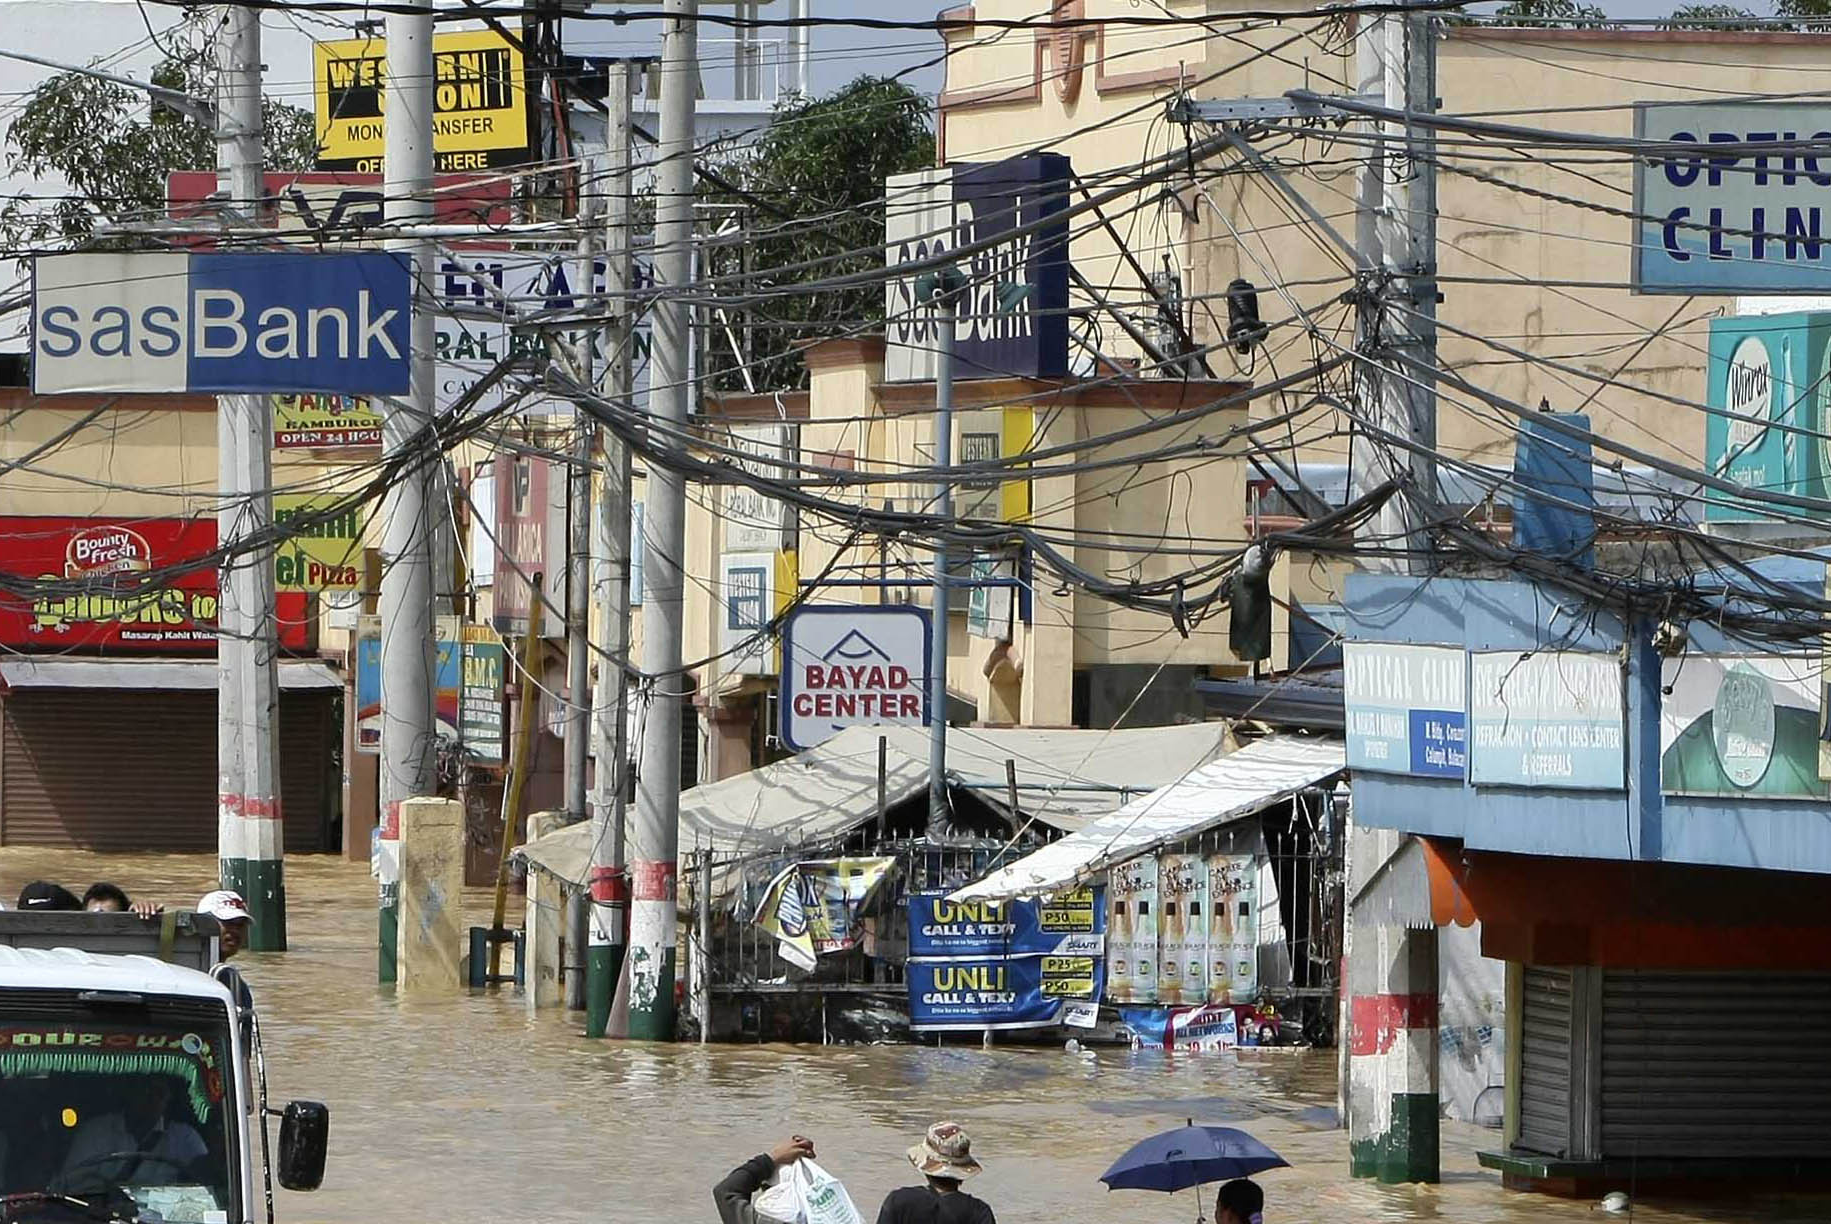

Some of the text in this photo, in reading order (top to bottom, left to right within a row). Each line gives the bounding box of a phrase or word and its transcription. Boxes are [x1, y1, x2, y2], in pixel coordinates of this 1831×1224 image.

[281, 430, 381, 444] OPEN 24 HOU
[76, 533, 130, 560] Bounty
[805, 665, 909, 690] BAYAD
[793, 693, 921, 718] CENTER
[922, 923, 1016, 937] CALL & TEXT
[933, 967, 1004, 990] UNLI
[922, 992, 1016, 1005] CALL & TEXT
